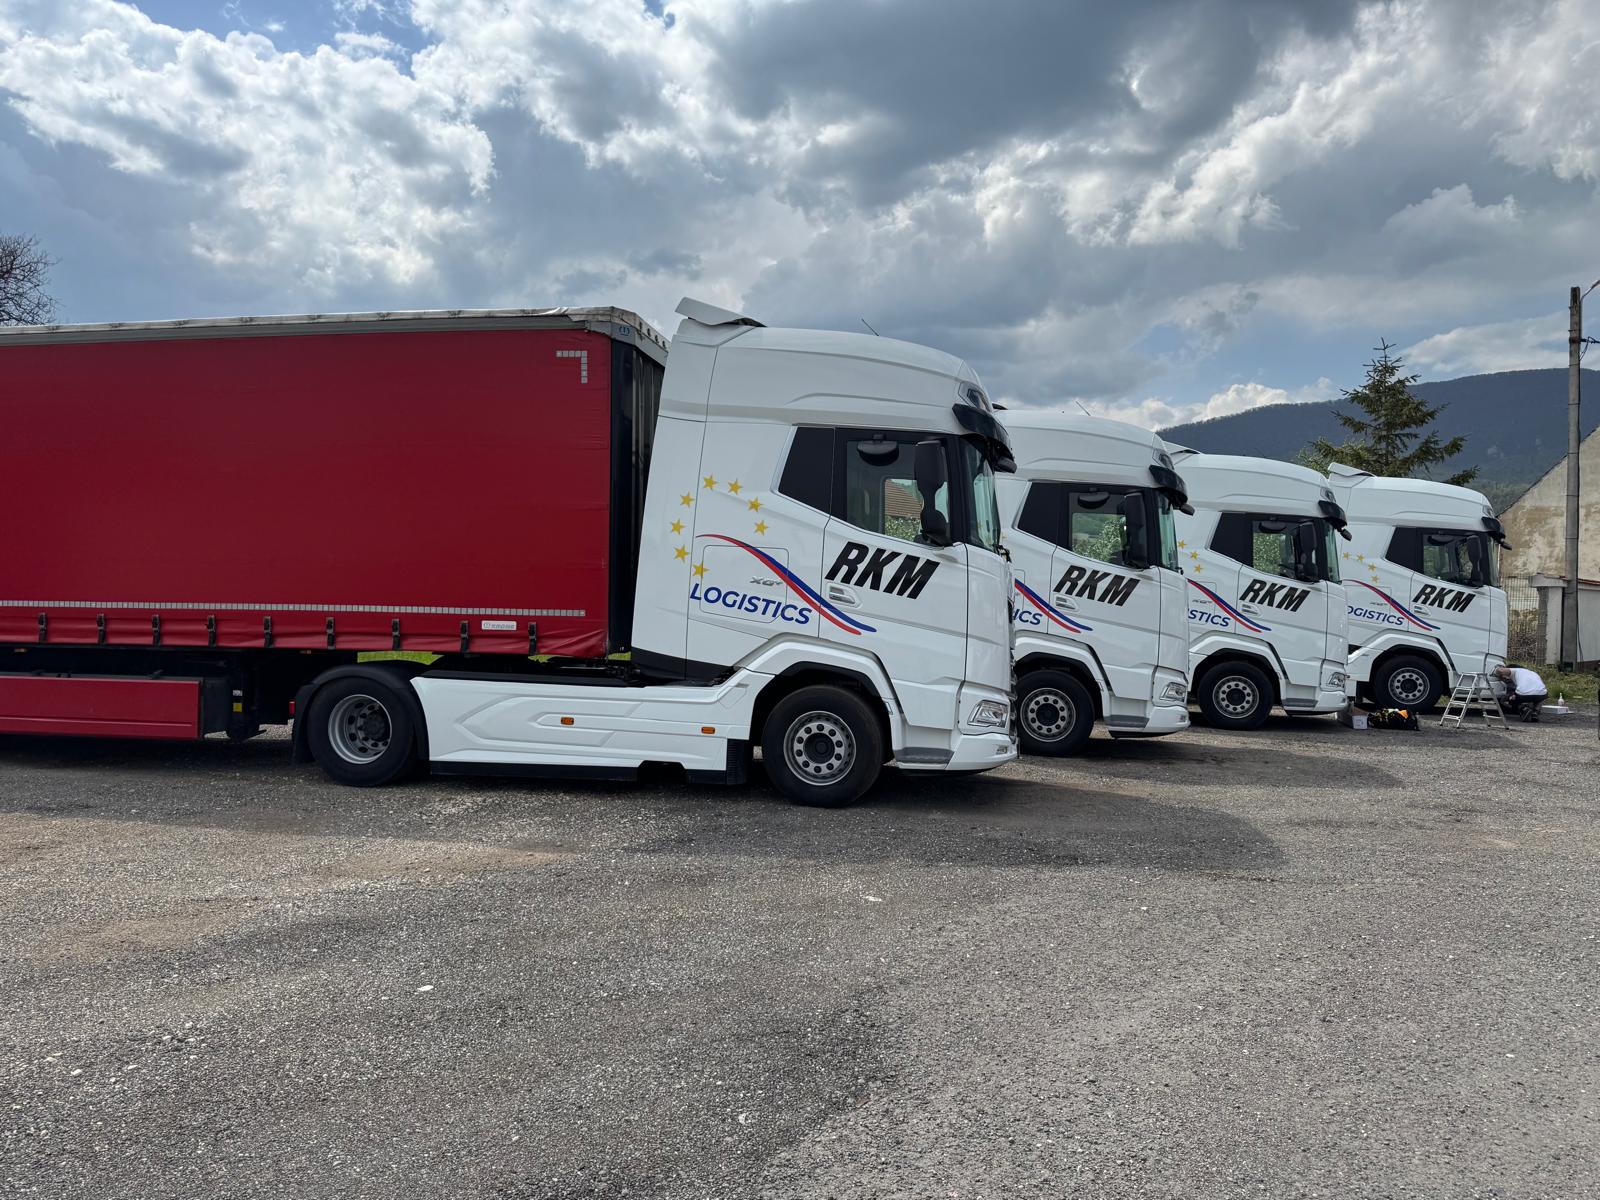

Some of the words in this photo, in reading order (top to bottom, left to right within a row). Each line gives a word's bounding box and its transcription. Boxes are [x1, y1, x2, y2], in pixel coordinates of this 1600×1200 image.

[824, 541, 940, 600] RKM
[1053, 565, 1141, 607] RKM
[689, 583, 813, 625] LOGISTICS
[1239, 578, 1311, 613] RKM
[1412, 583, 1476, 613] RKM
[1188, 608, 1231, 627] STICS
